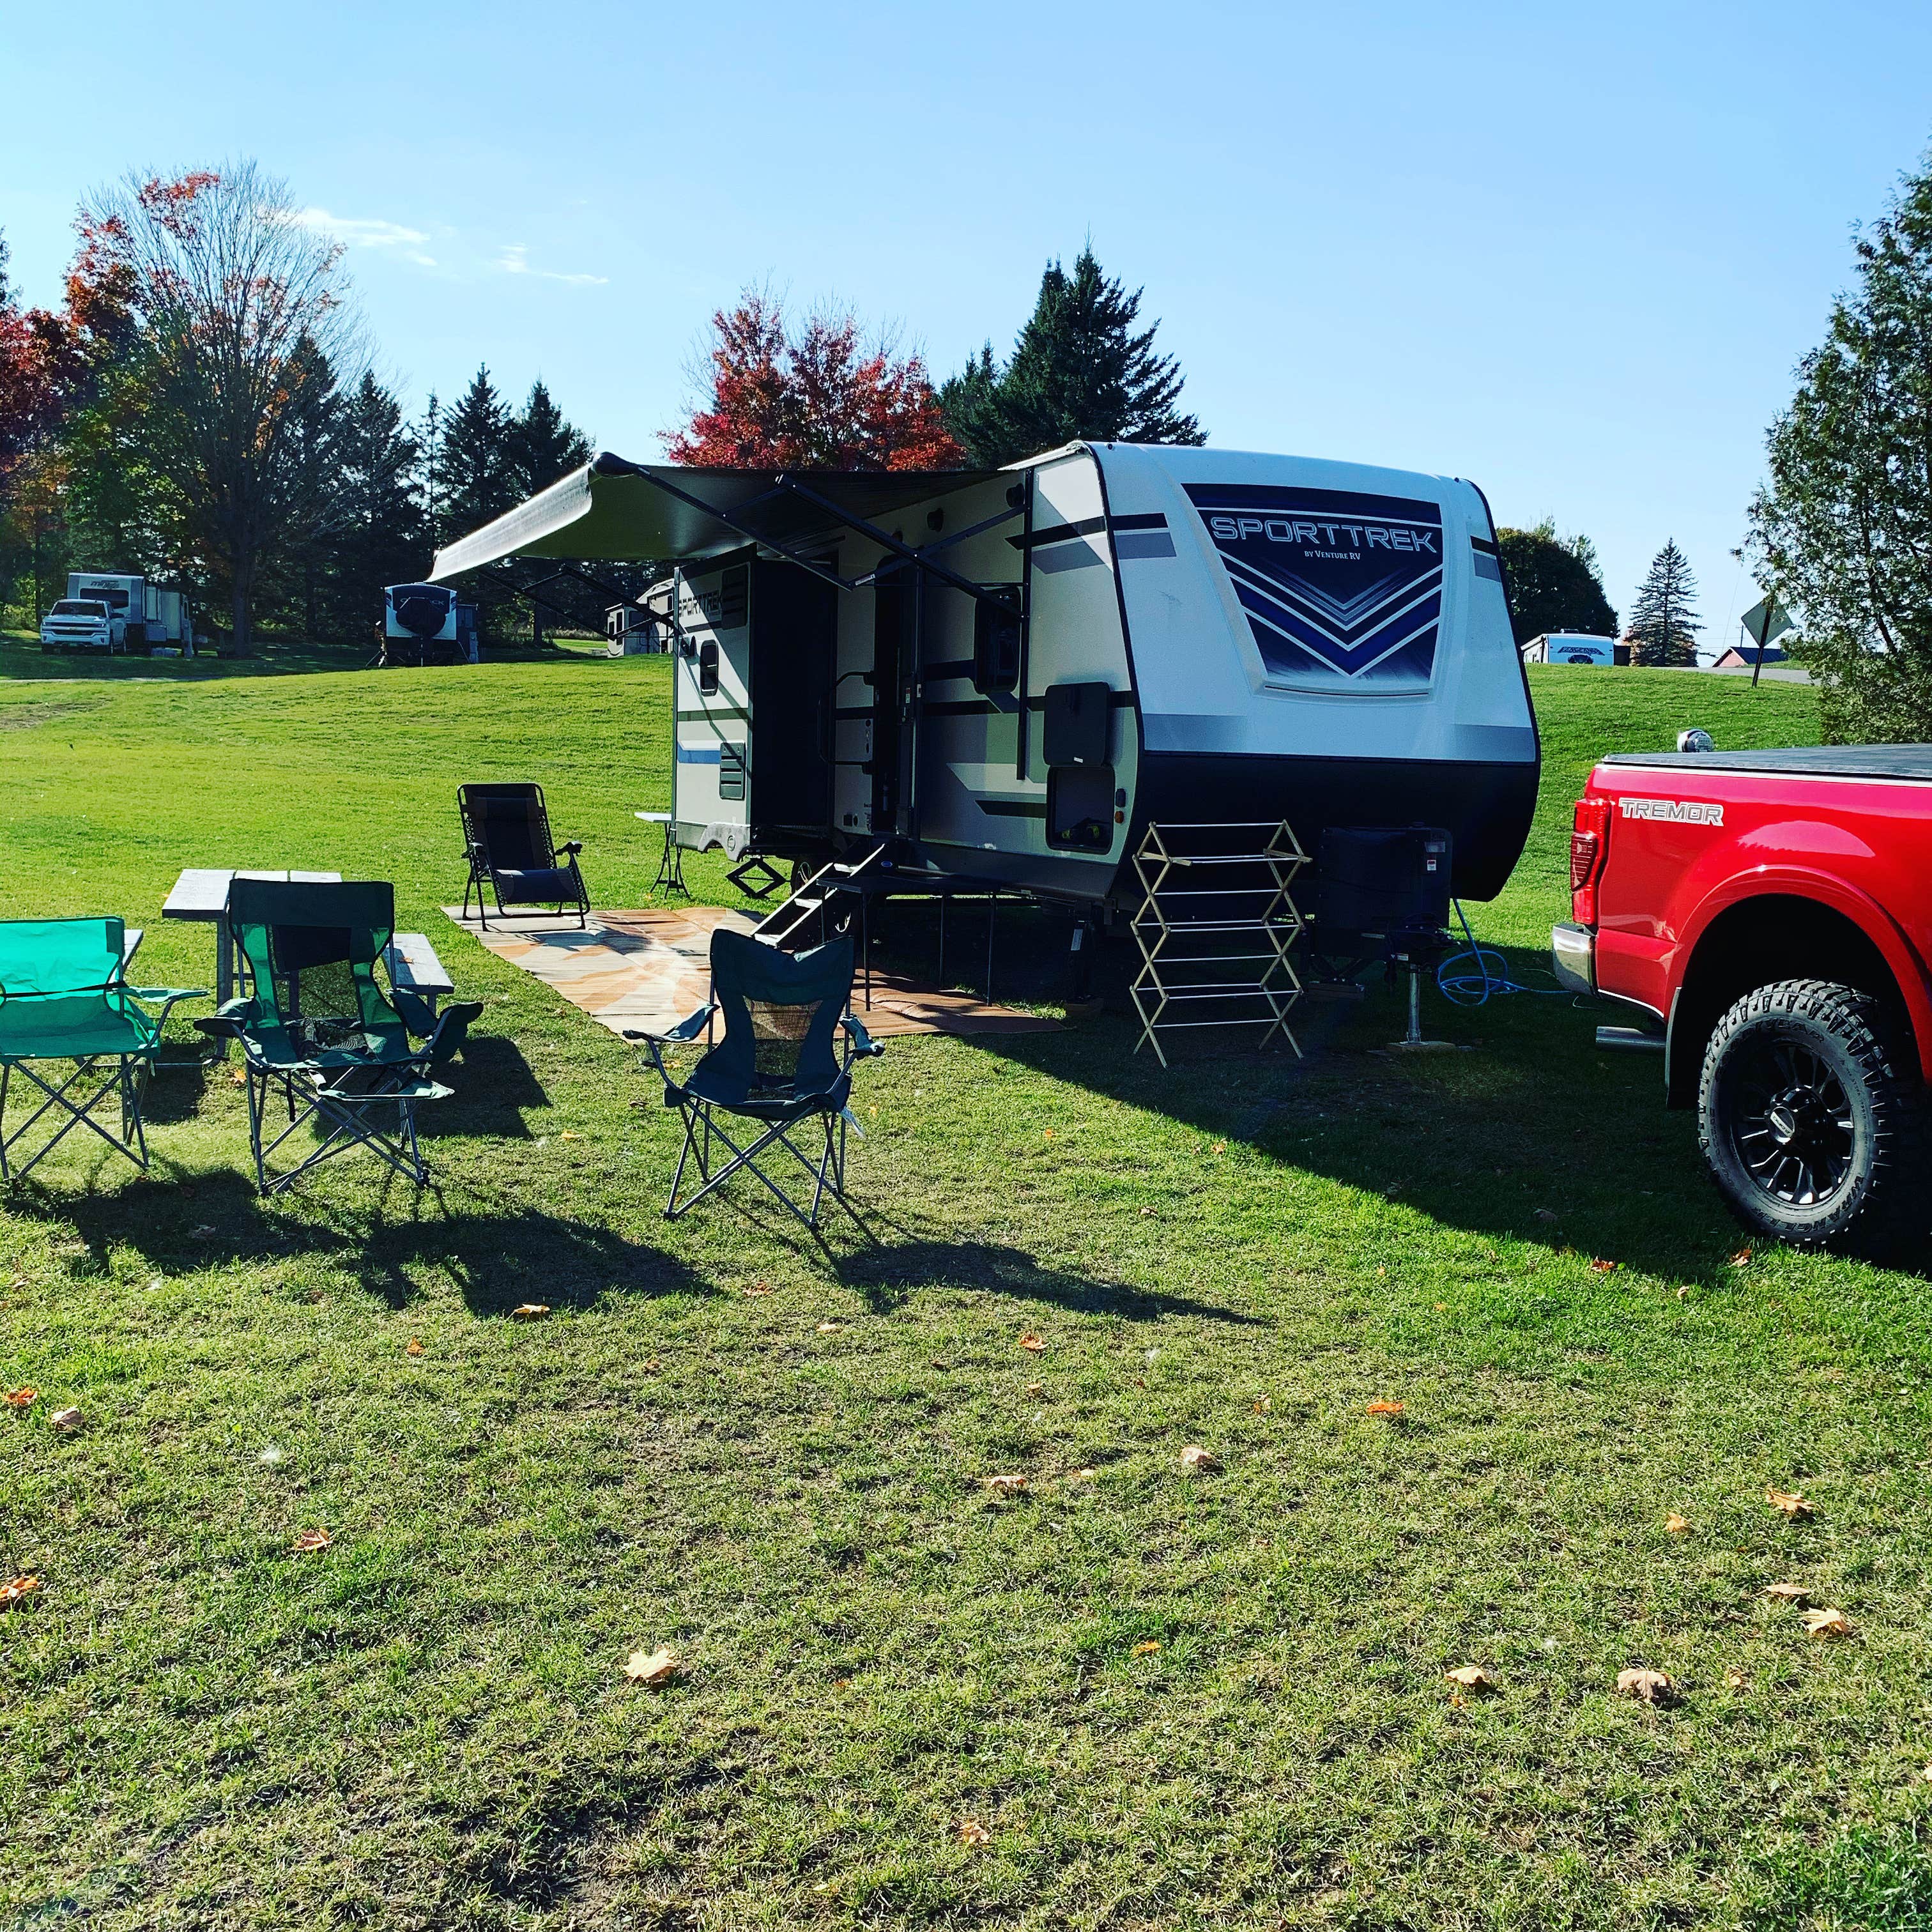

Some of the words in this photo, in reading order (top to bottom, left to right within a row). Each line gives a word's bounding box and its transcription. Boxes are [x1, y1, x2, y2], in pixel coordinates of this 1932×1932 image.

[1210, 516, 1437, 553] SPORTTREK
[1349, 552, 1361, 560] RV
[1618, 797, 1724, 827] TREMOR
